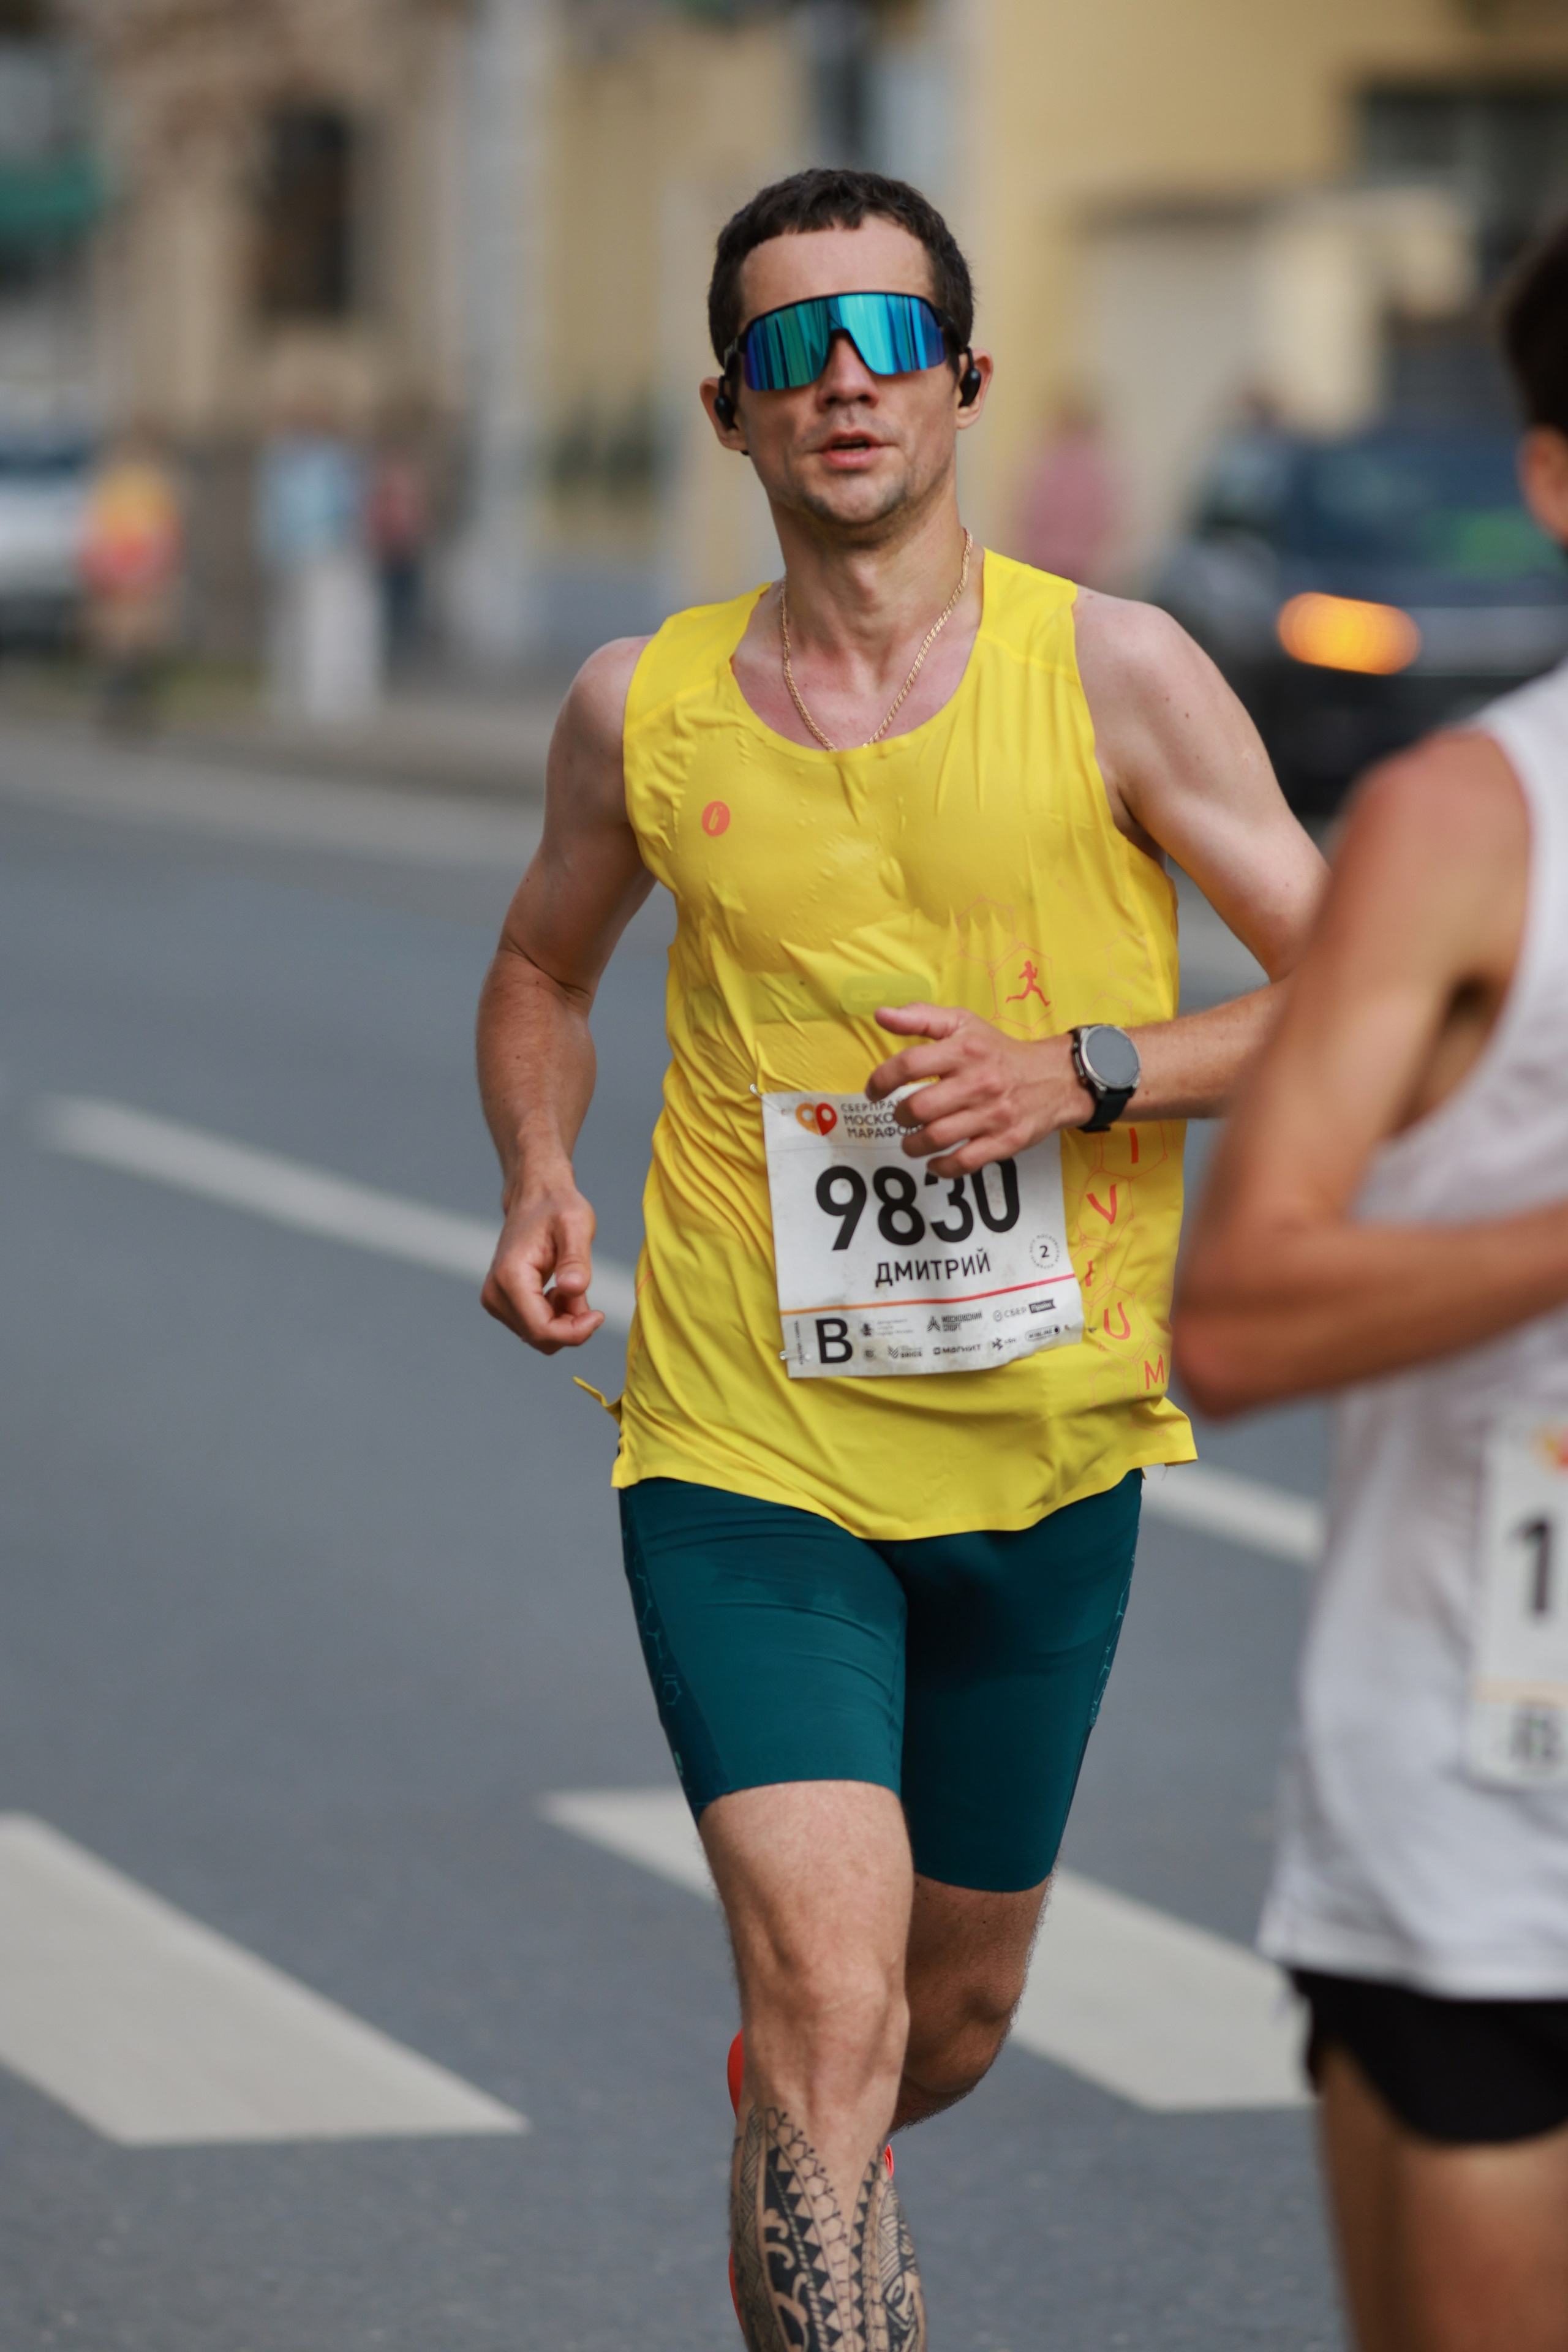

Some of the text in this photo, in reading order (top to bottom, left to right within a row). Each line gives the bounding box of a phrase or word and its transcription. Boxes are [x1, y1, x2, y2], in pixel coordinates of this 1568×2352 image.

[840, 1099, 899, 1113] СБЕРПРА
[843, 1112, 894, 1126] МОСКО
[846, 1126, 919, 1139] МАРАФО
[815, 1156, 1020, 1251] 9830
[1039, 1245, 1049, 1258] 2
[875, 1247, 990, 1287] ДМИТРИЙ
[1004, 1306, 1027, 1318] СБЕР
[815, 1318, 853, 1364] B
